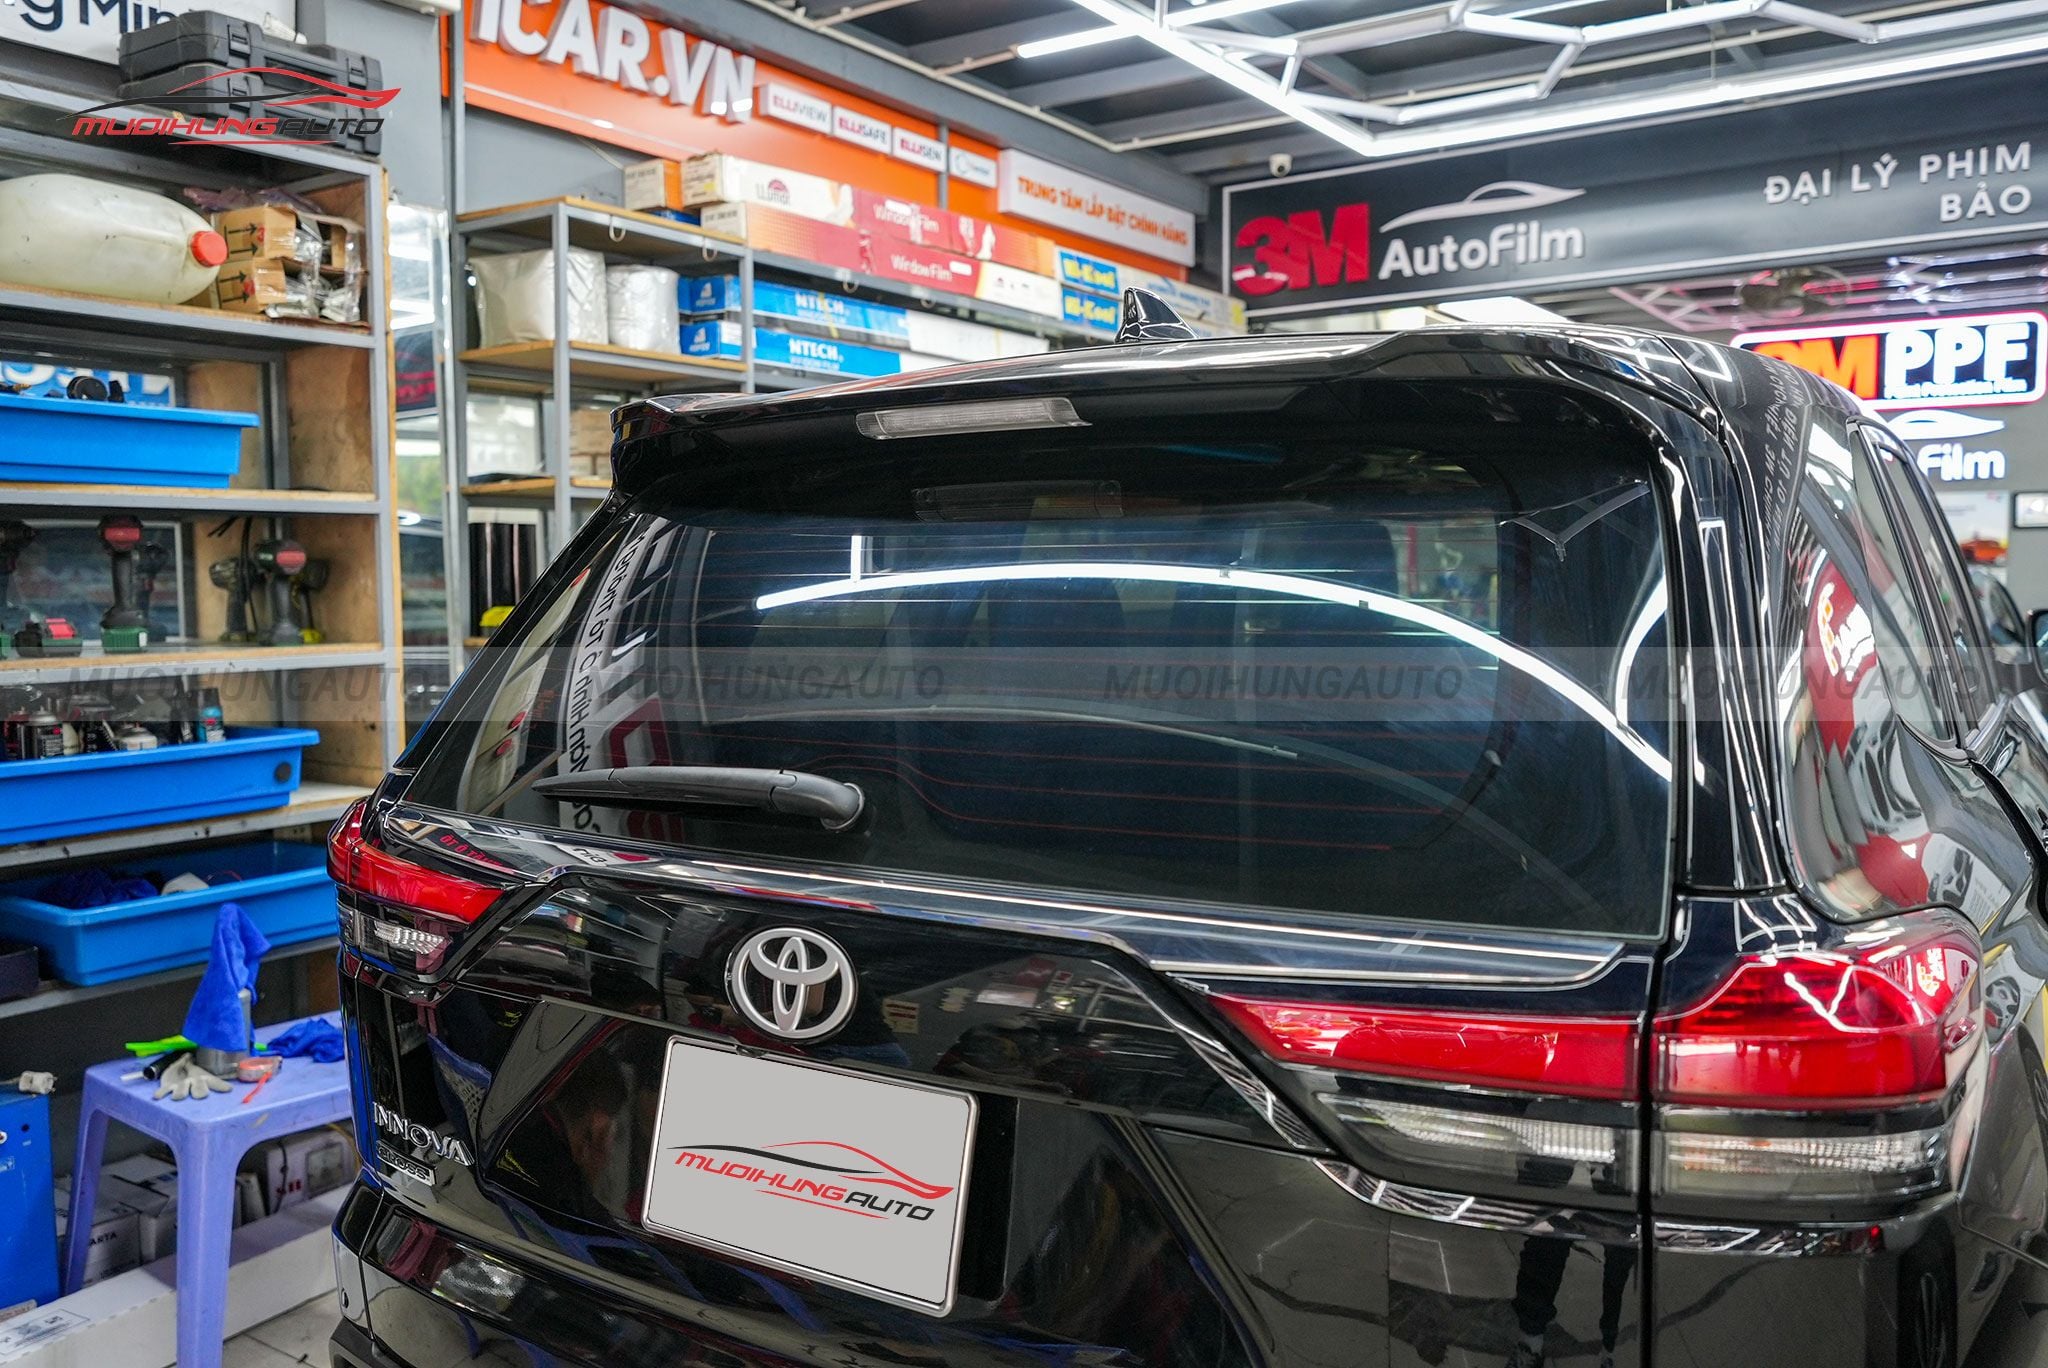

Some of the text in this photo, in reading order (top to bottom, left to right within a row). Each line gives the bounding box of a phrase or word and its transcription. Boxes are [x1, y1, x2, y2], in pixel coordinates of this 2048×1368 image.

[1018, 176, 1057, 204] TRUNG
[1763, 168, 1831, 205] ĐẠI
[1919, 141, 2032, 183] PHIM
[1232, 203, 1371, 296] 3M
[1378, 219, 1585, 281] AutoFilm
[1884, 321, 2030, 384] PPF
[372, 1101, 475, 1167] INNOVA
[378, 1145, 432, 1182] CROSS
[89, 1231, 118, 1247] ARTA
